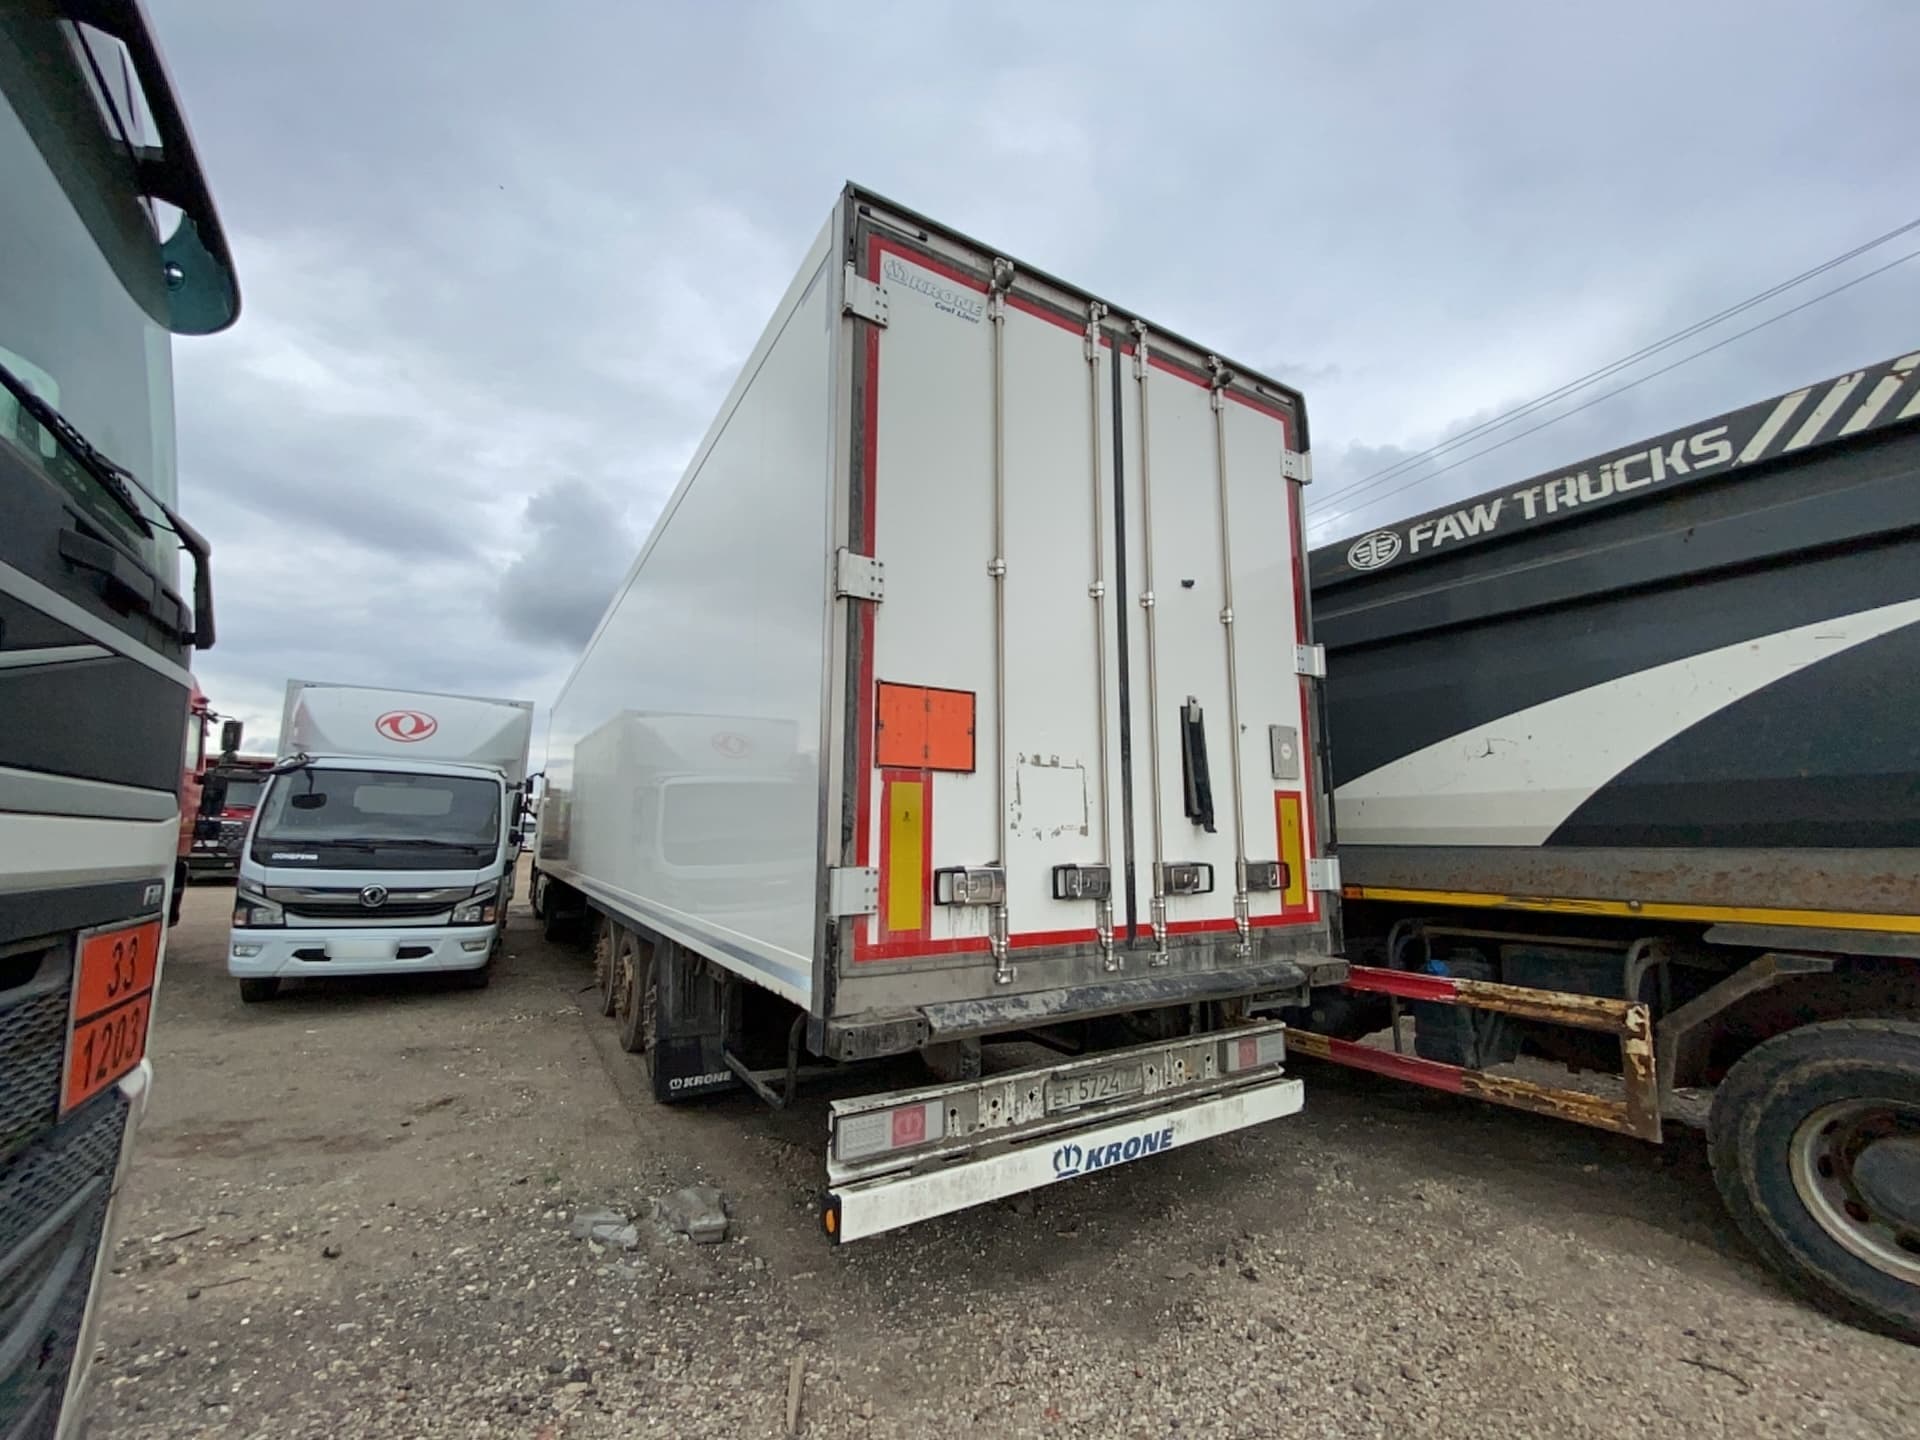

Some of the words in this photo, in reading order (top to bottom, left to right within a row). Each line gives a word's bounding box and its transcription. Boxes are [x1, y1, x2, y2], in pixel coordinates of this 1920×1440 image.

[909, 275, 984, 317] KRONE
[1408, 497, 1504, 554] FAW
[1513, 425, 1733, 521] TRUCKS
[107, 935, 139, 998] 33
[83, 1007, 141, 1090] 1203
[683, 1070, 732, 1088] KRONE
[1080, 1071, 1120, 1100] 5724
[1085, 1127, 1175, 1172] KRONE
